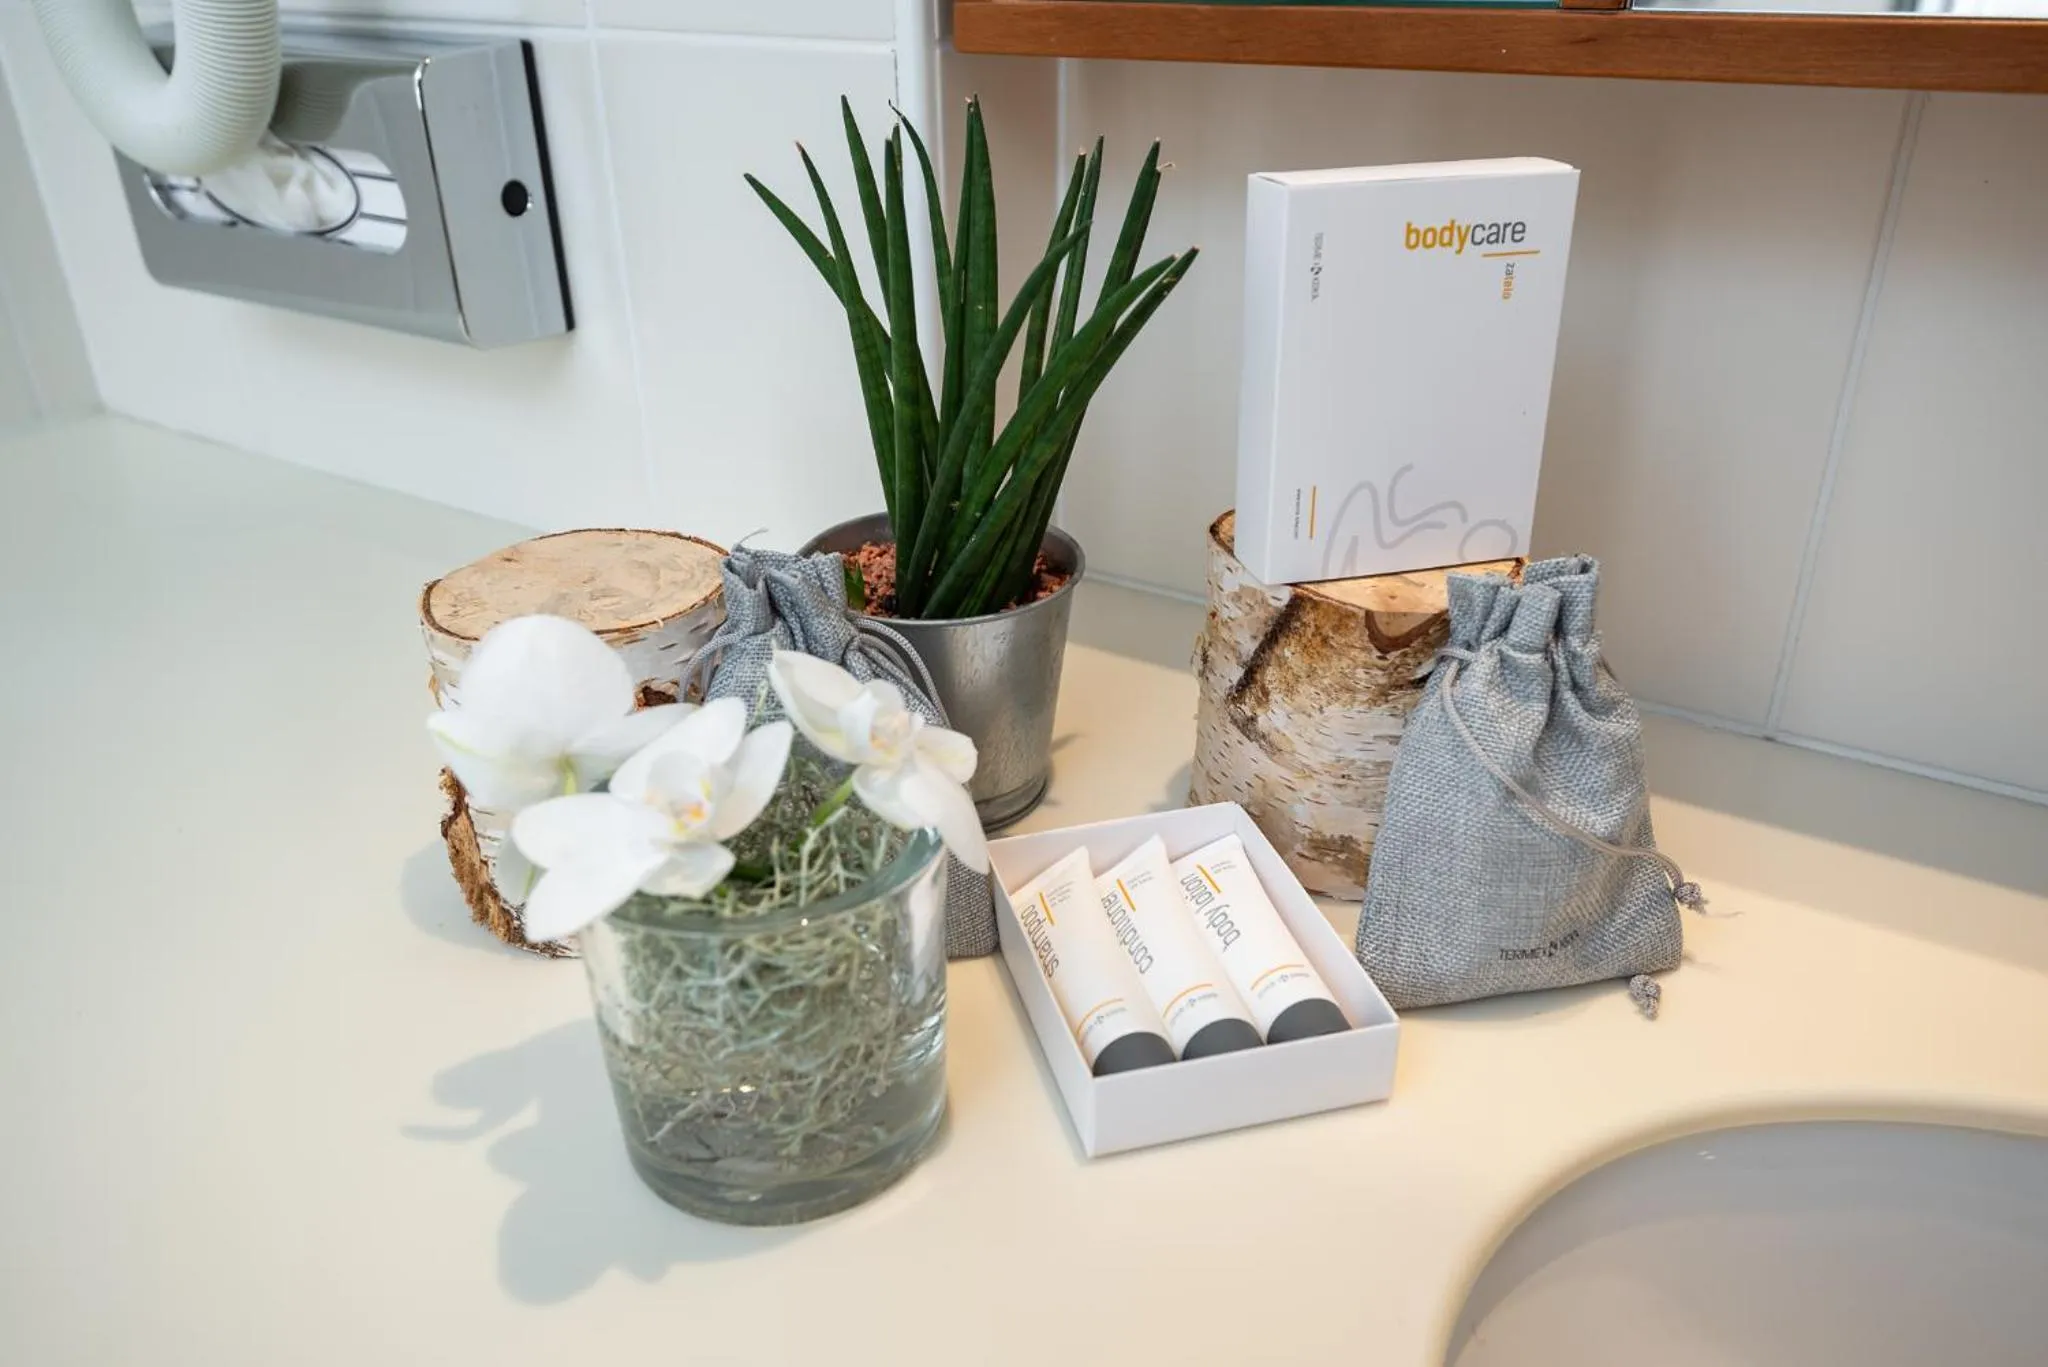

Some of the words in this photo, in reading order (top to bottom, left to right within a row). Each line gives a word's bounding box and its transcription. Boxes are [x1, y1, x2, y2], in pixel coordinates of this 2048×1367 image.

[1405, 219, 1526, 255] bodycare
[1180, 873, 1215, 914] lotion
[1021, 904, 1060, 978] shampoo
[1101, 890, 1154, 974] conditioner
[1204, 904, 1241, 953] body
